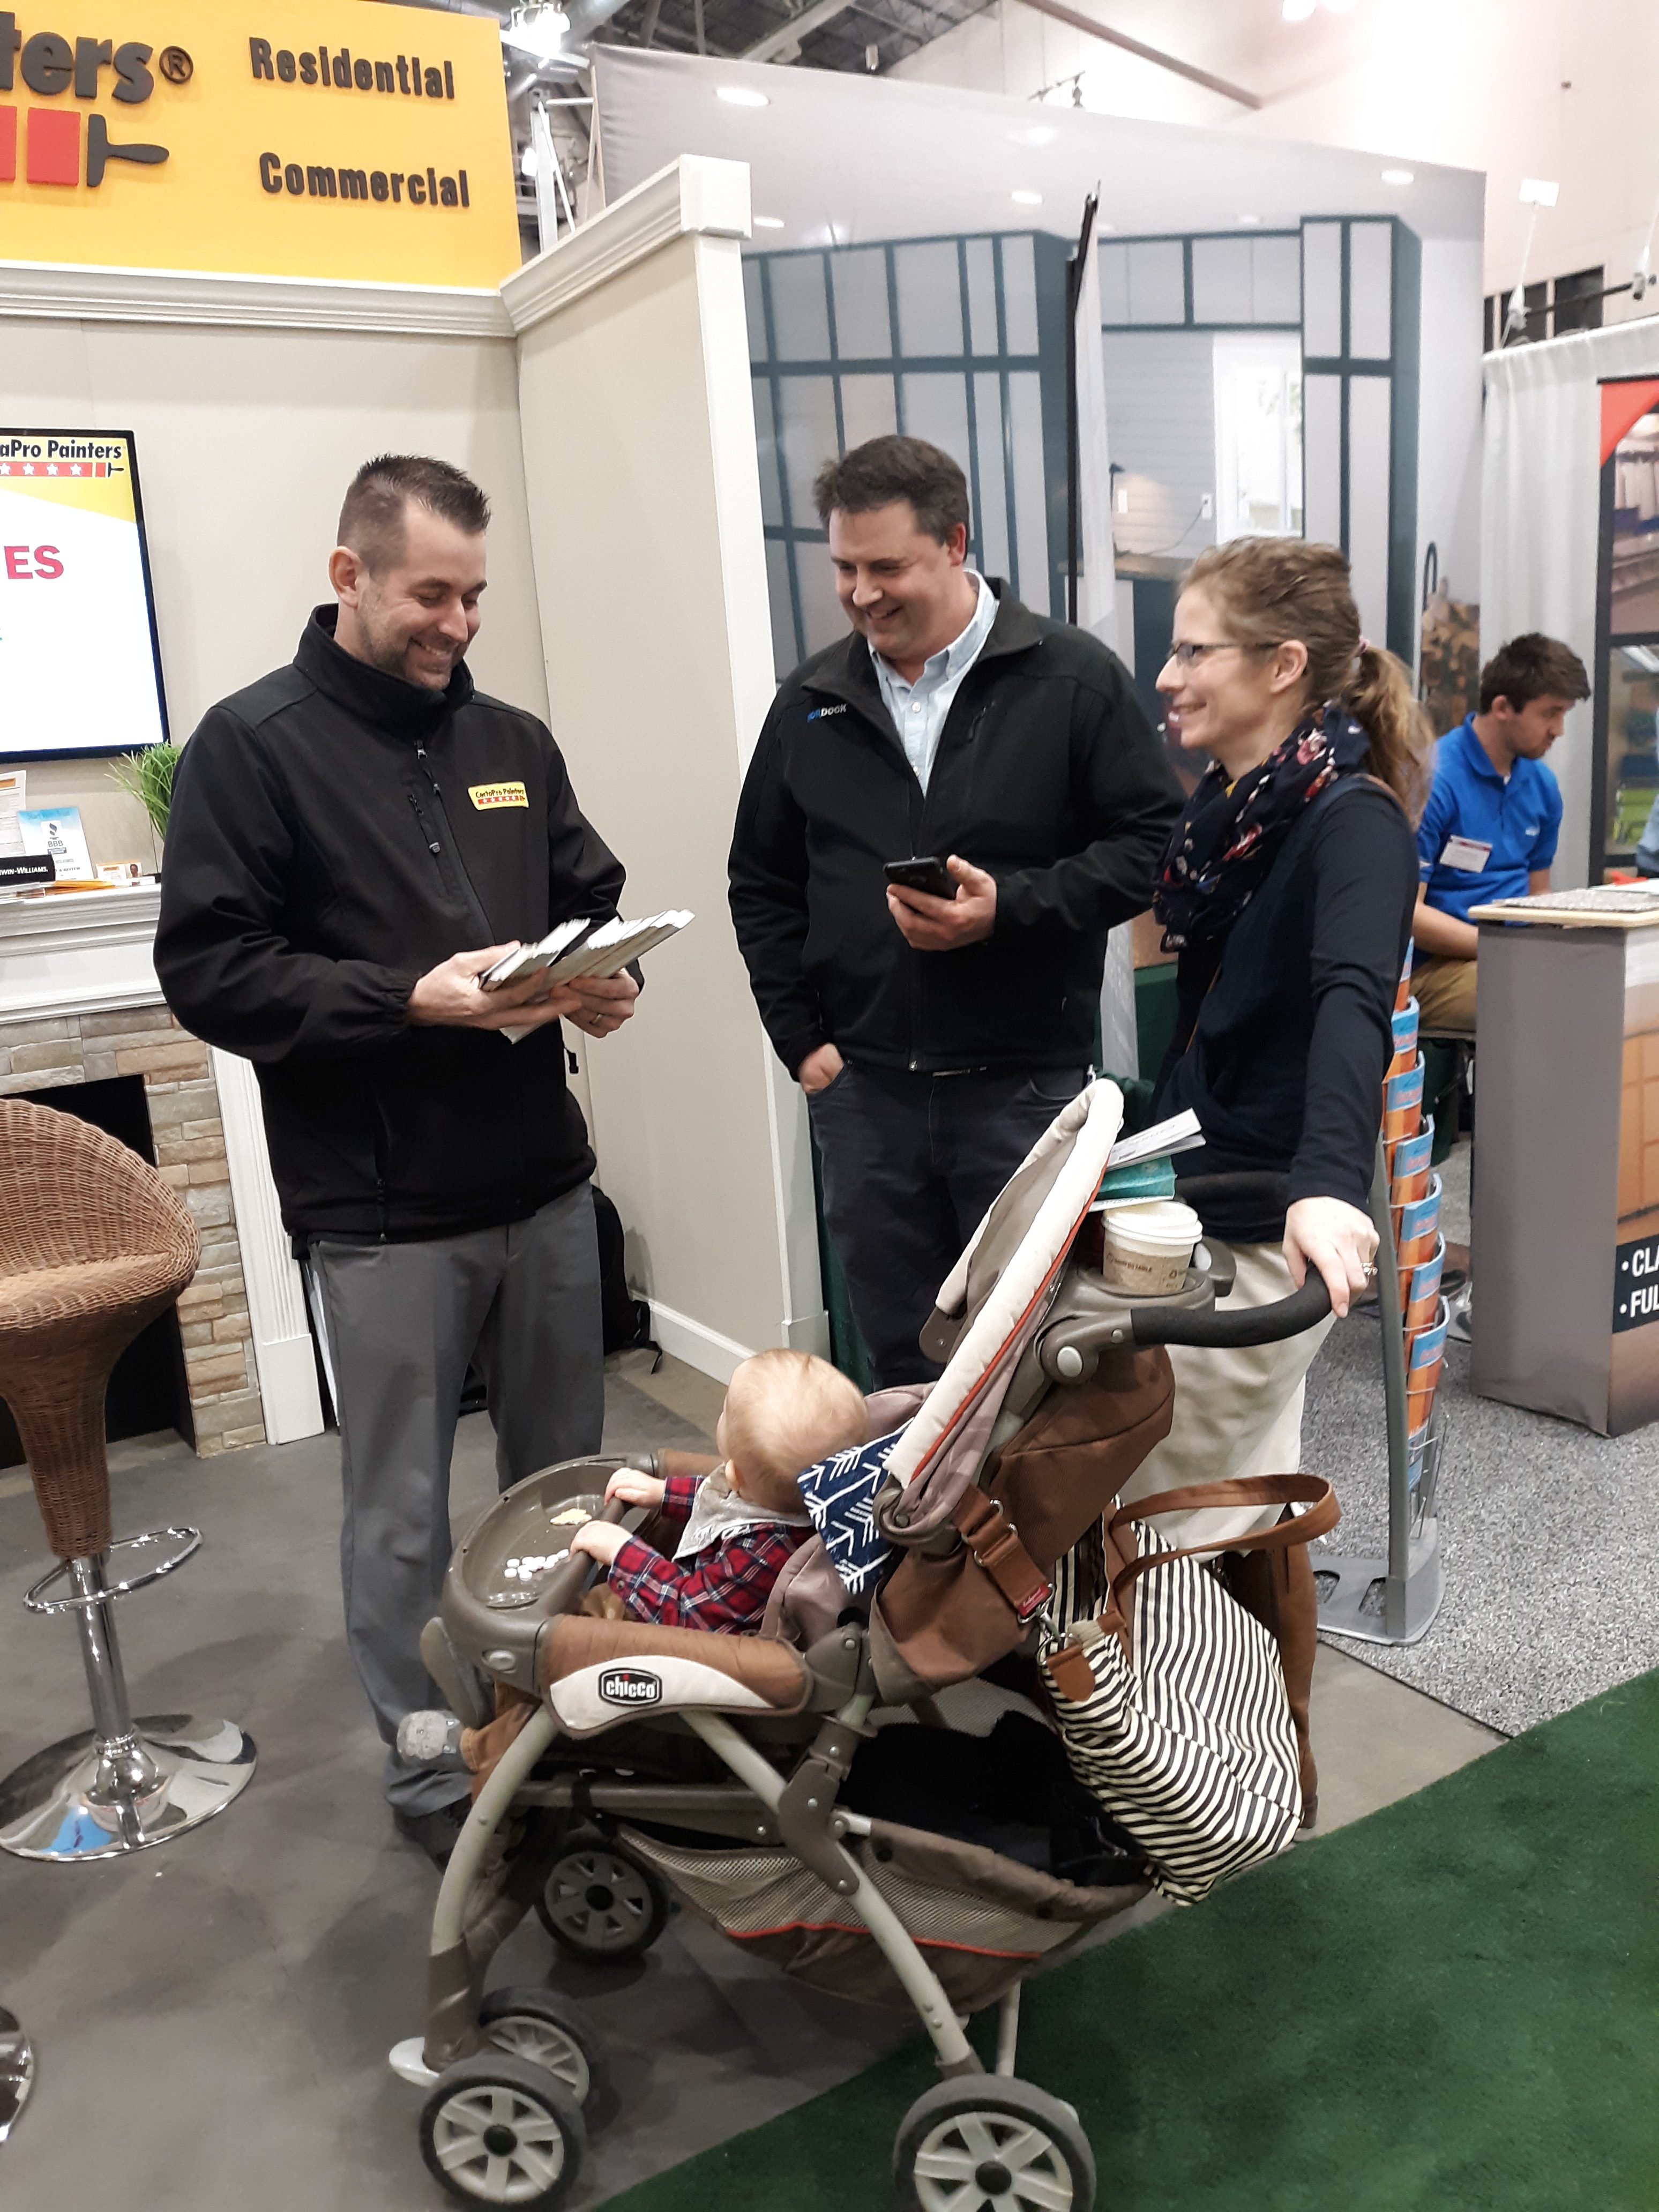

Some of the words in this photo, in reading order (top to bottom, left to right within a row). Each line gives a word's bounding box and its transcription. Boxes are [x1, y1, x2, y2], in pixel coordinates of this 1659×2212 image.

[249, 37, 454, 99] Residential
[259, 152, 469, 207] Commercial
[0, 439, 41, 458] aPro
[48, 439, 122, 459] Painters
[4, 545, 64, 579] ES
[606, 1673, 656, 1698] chicco
